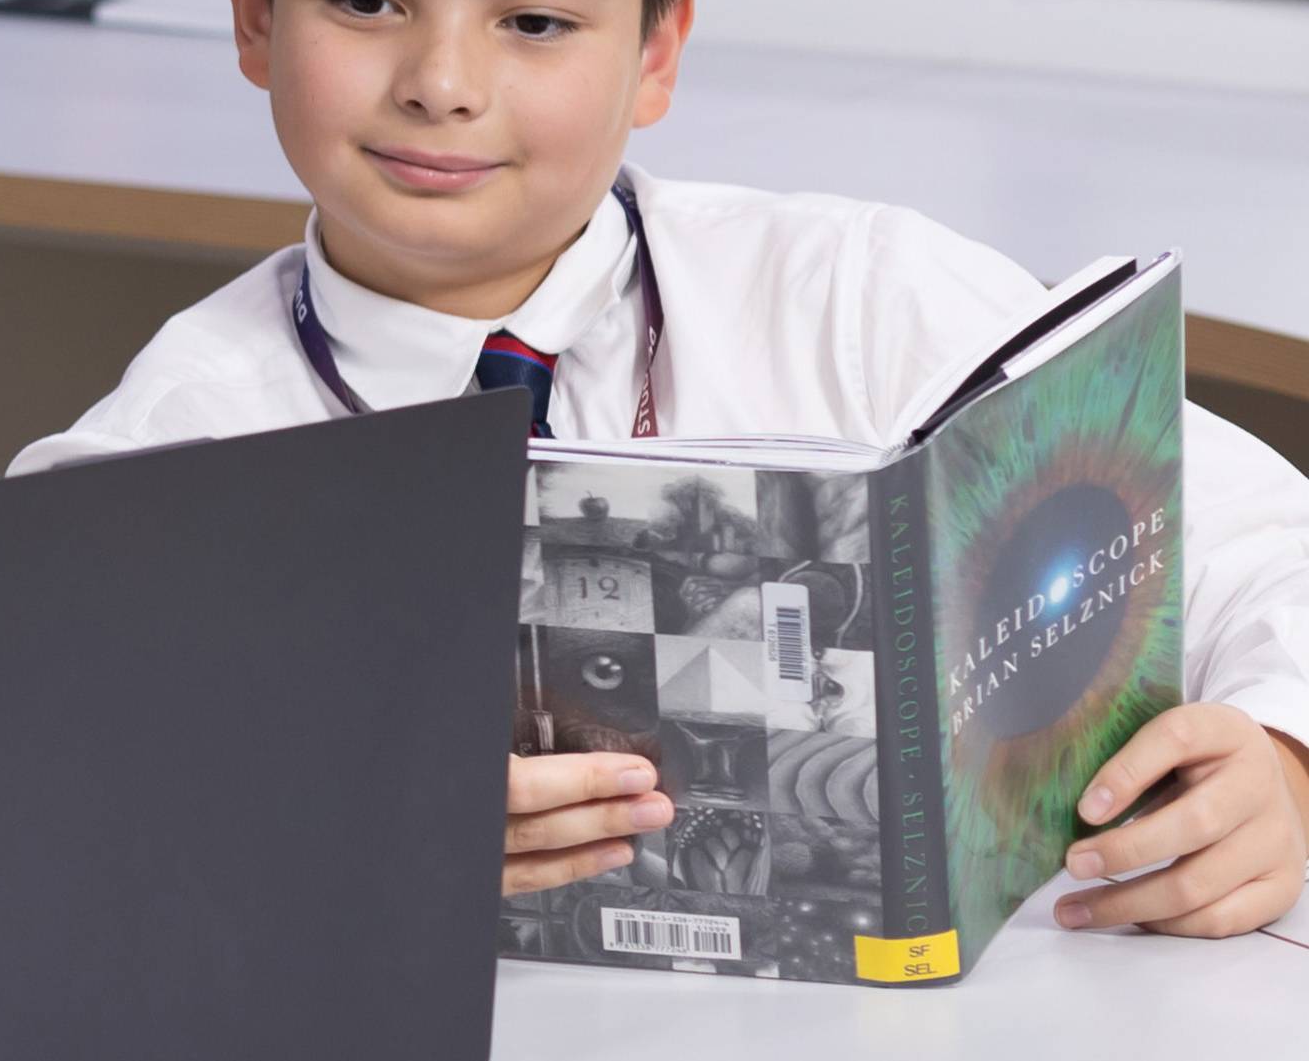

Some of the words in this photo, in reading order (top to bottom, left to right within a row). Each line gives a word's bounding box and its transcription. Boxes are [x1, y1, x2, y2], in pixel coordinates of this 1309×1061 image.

[578, 576, 621, 600] 12
[887, 493, 921, 763] KALEIDOSCOPE
[947, 507, 1166, 697] KALEIDSCOPE
[951, 652, 1019, 736] BRIAN
[1031, 549, 1165, 658] SELZNICK
[900, 792, 929, 933] SELZNIC
[904, 962, 937, 977] SEL
[908, 944, 931, 958] SF
